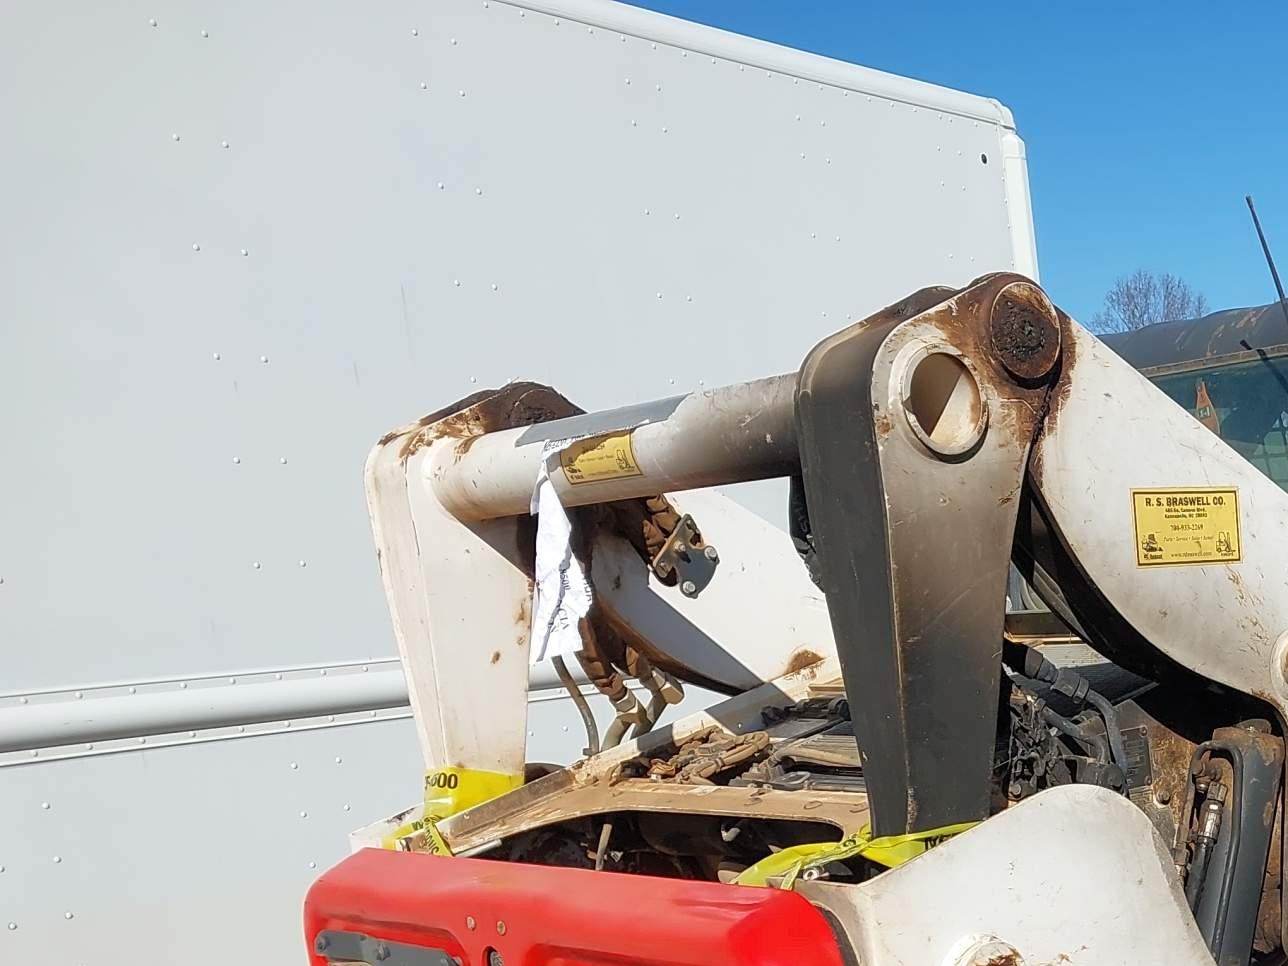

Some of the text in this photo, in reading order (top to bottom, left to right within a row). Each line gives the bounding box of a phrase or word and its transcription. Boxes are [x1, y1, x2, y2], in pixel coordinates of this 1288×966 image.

[1145, 496, 1226, 507] R. S. BRASWELL CO.
